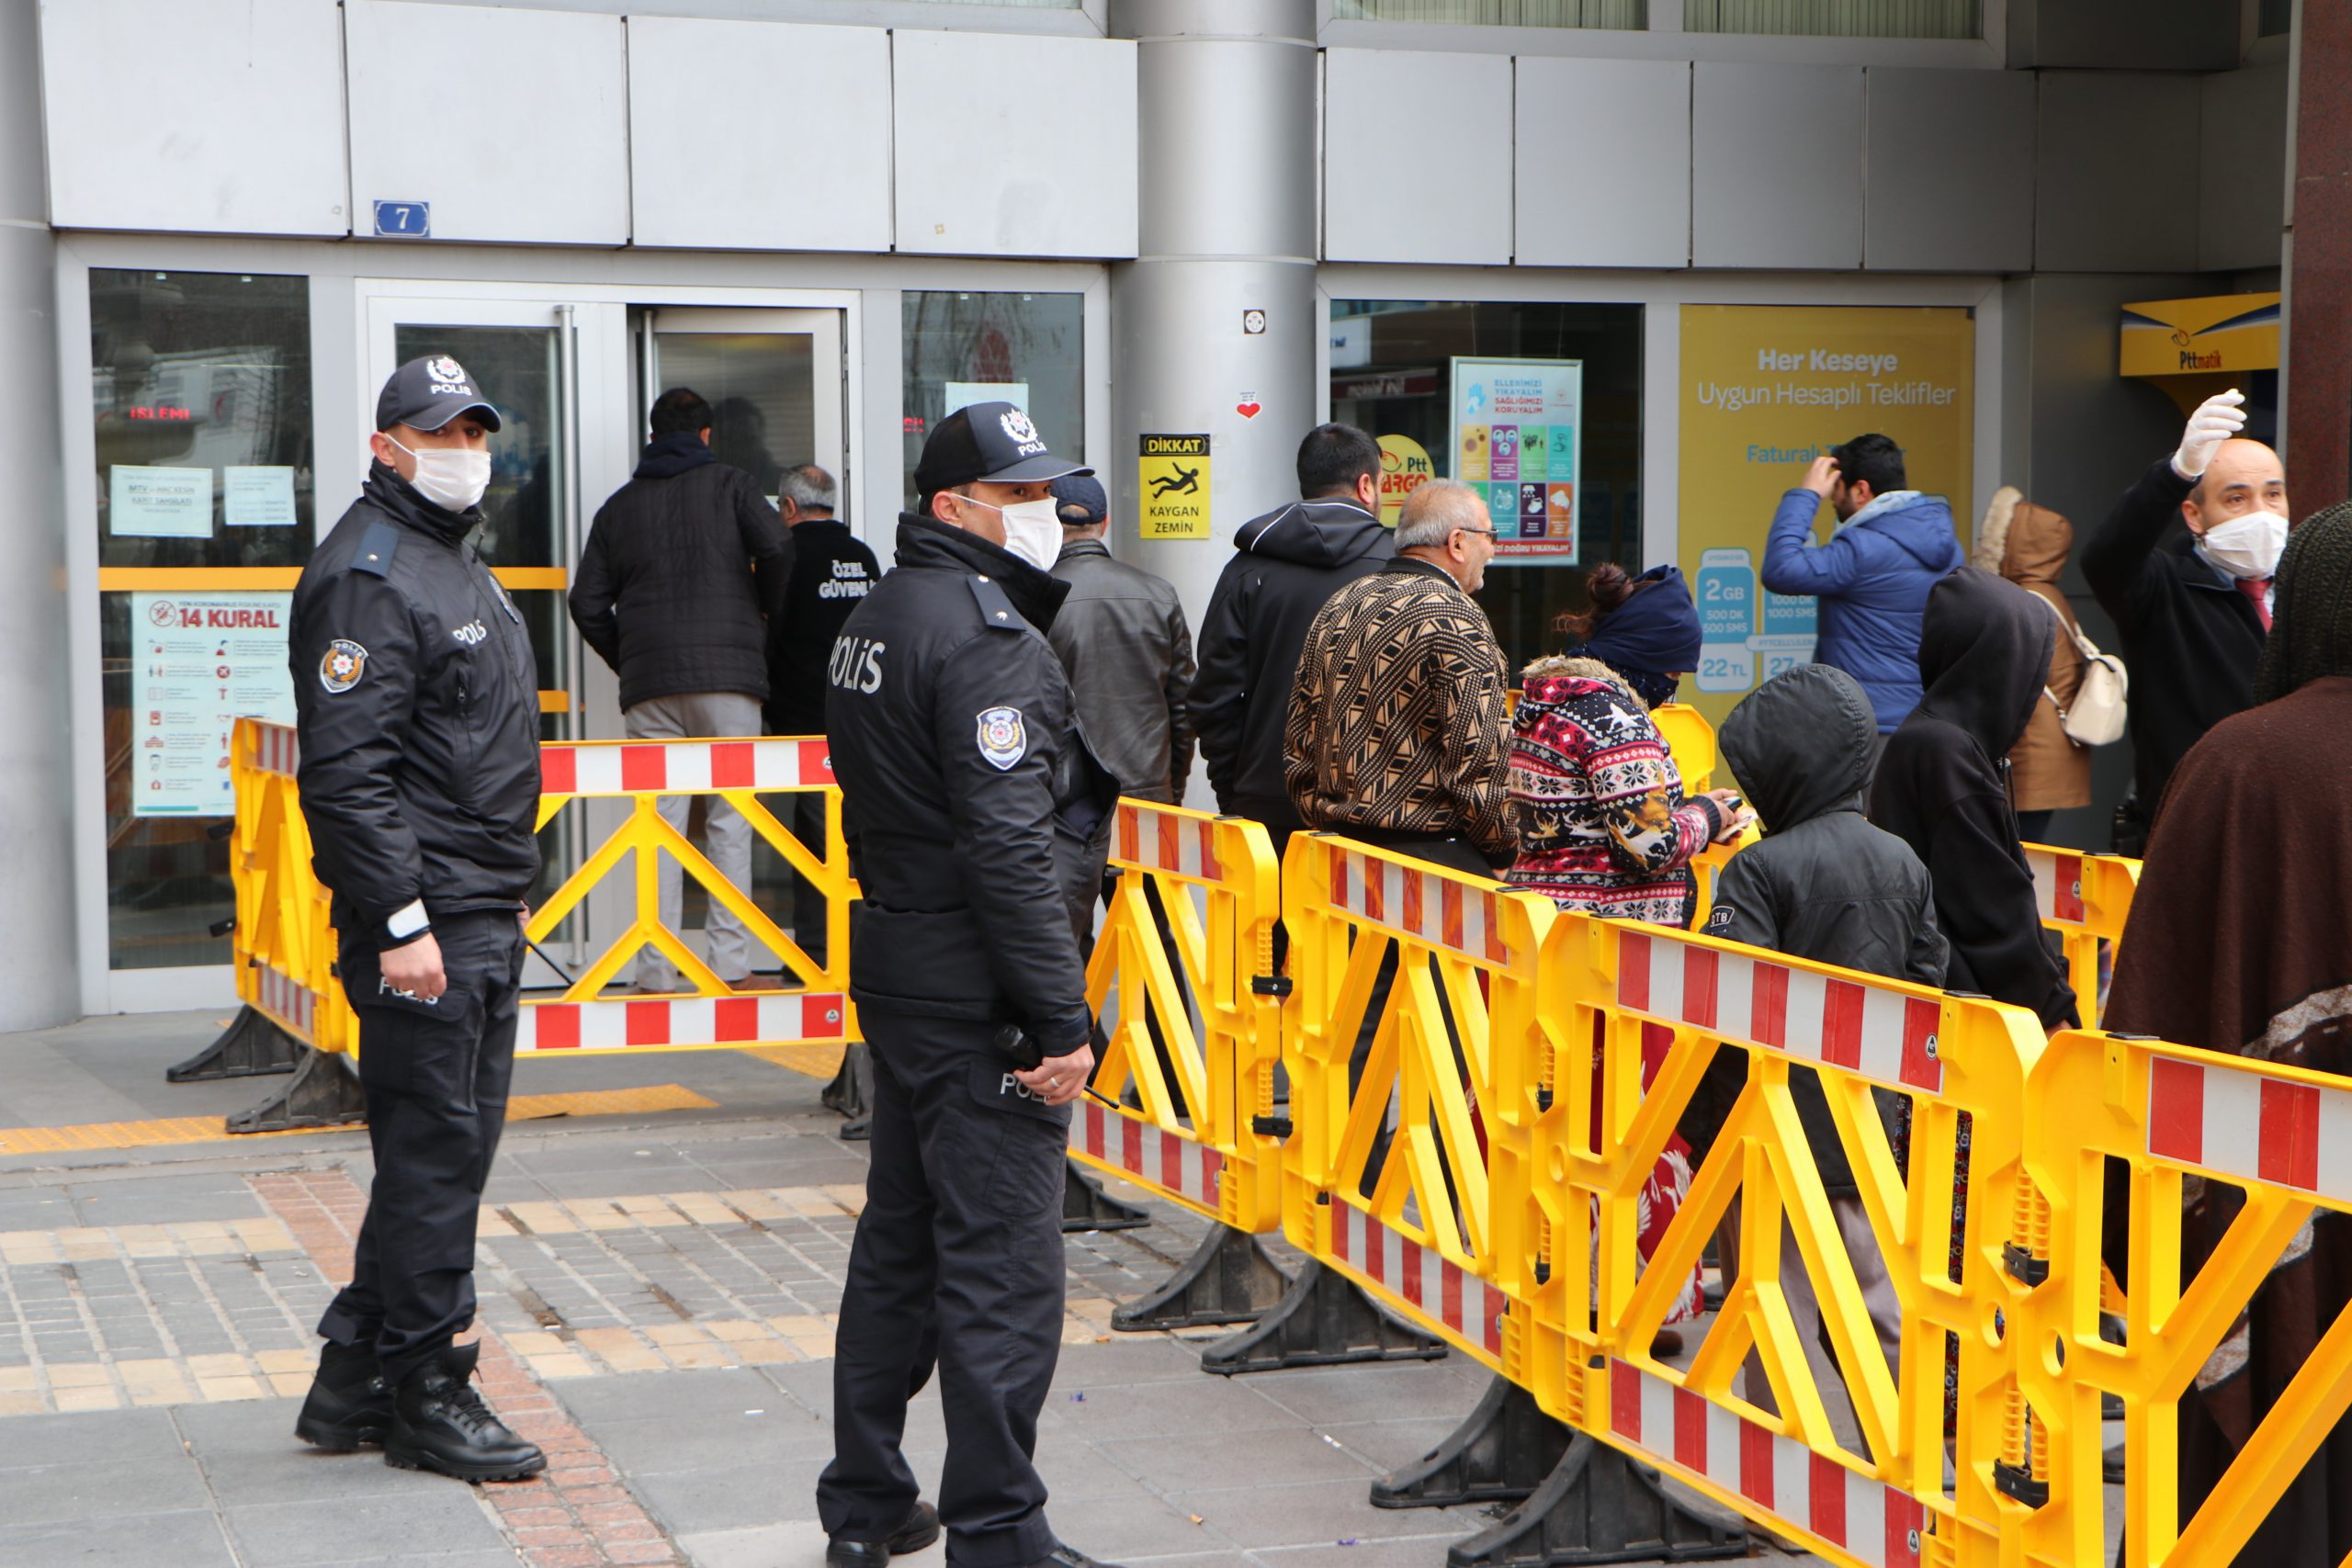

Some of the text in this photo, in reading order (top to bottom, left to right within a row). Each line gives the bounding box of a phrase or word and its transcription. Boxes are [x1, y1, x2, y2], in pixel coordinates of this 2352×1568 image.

[396, 208, 411, 230] 7
[1758, 348, 1898, 377] Her Keseye
[2179, 350, 2222, 369] Pttmatik
[1698, 381, 1956, 412] Uygun Hesaplı Teklifler
[1148, 436, 1202, 453] DİKKAT
[1408, 457, 1428, 472] Ptt
[1381, 473, 1428, 493] ARGO
[1149, 506, 1199, 517] KAYGAN
[1154, 521, 1193, 534] ZEMİN
[831, 559, 867, 578] ÖZEL
[1705, 578, 1745, 602] 2 GB
[178, 608, 279, 628] 14 KURAL
[1706, 610, 1745, 620] 500 DK
[1769, 608, 1794, 618] 1000
[1703, 622, 1747, 633] 500 SMS
[828, 636, 886, 694] POLİS
[1702, 658, 1747, 677] 22 TL
